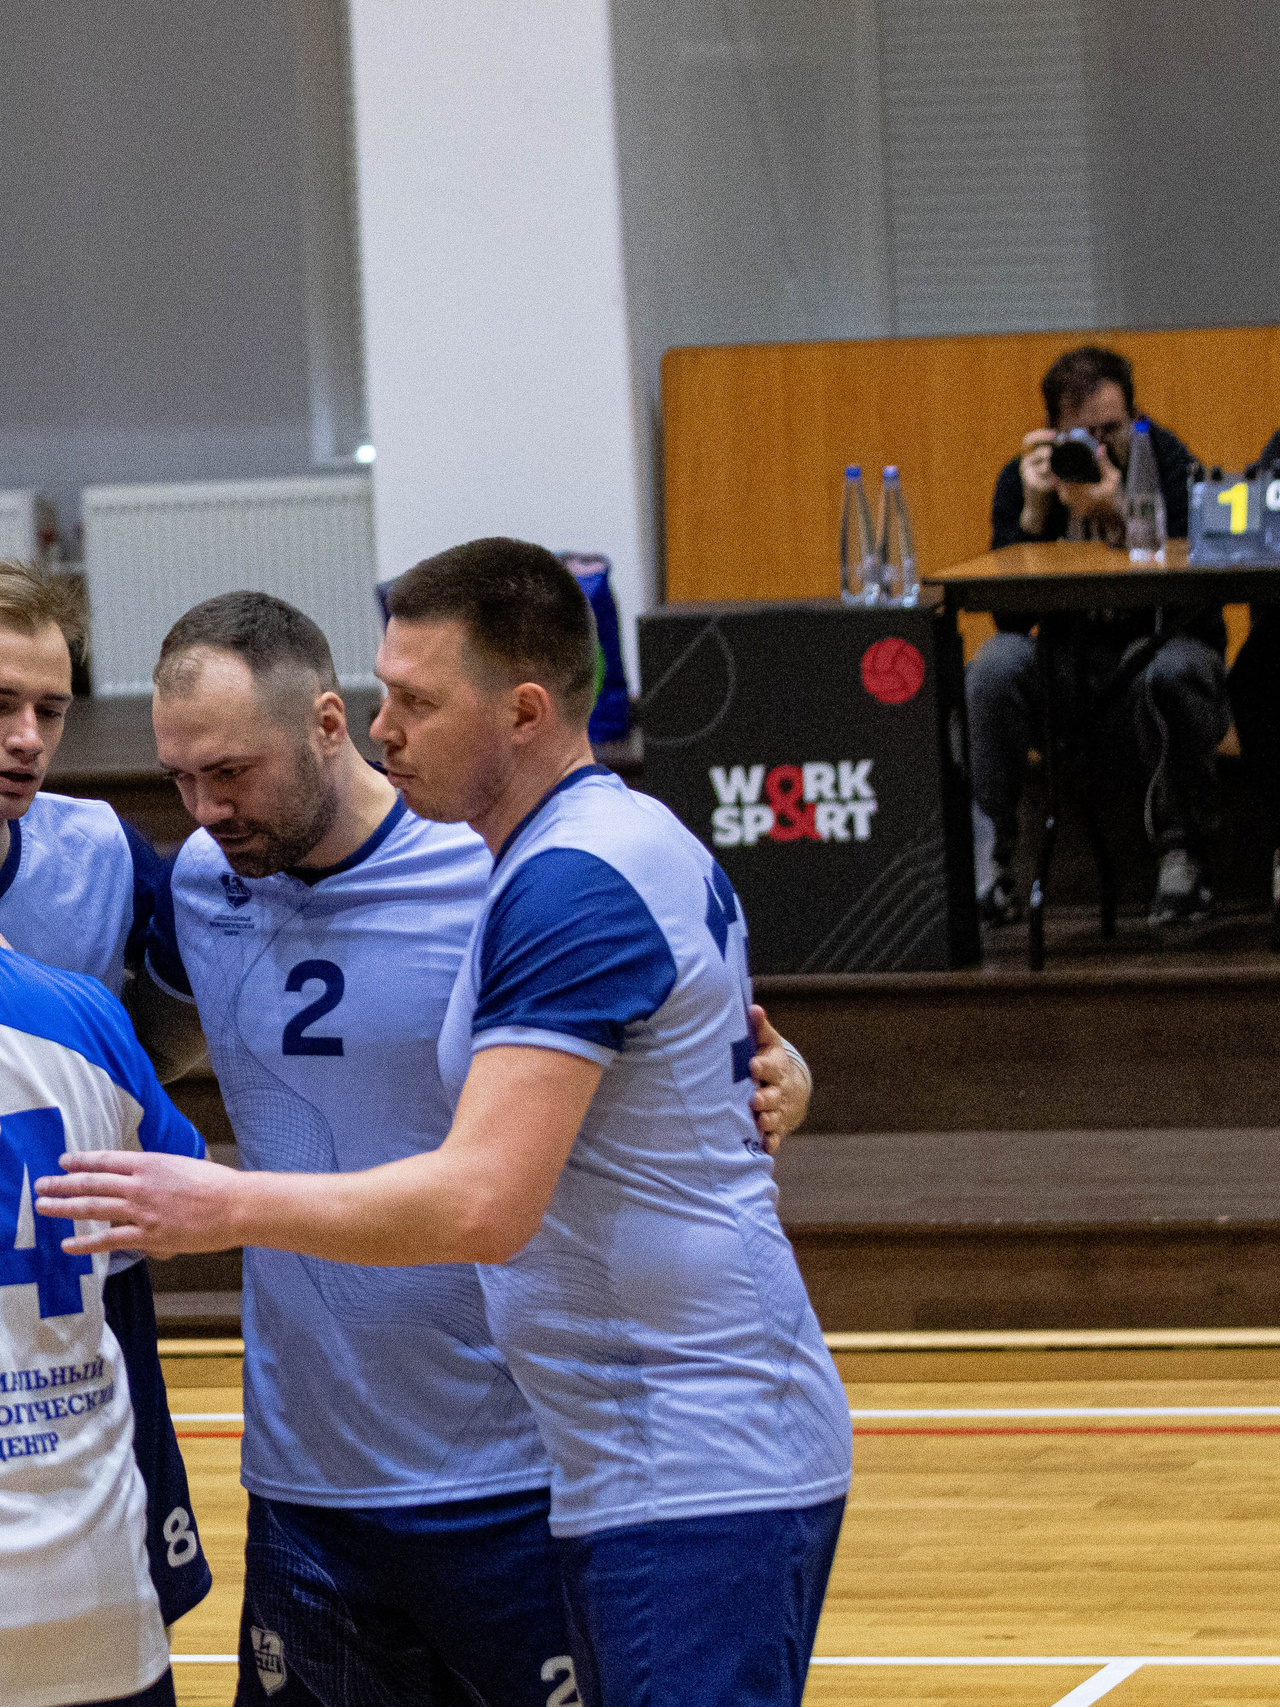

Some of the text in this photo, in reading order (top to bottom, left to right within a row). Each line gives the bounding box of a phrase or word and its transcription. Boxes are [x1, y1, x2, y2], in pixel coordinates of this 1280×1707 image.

[1217, 482, 1248, 534] 1
[282, 959, 345, 1056] 2
[163, 1506, 197, 1568] 8
[540, 1655, 584, 1707] 2
